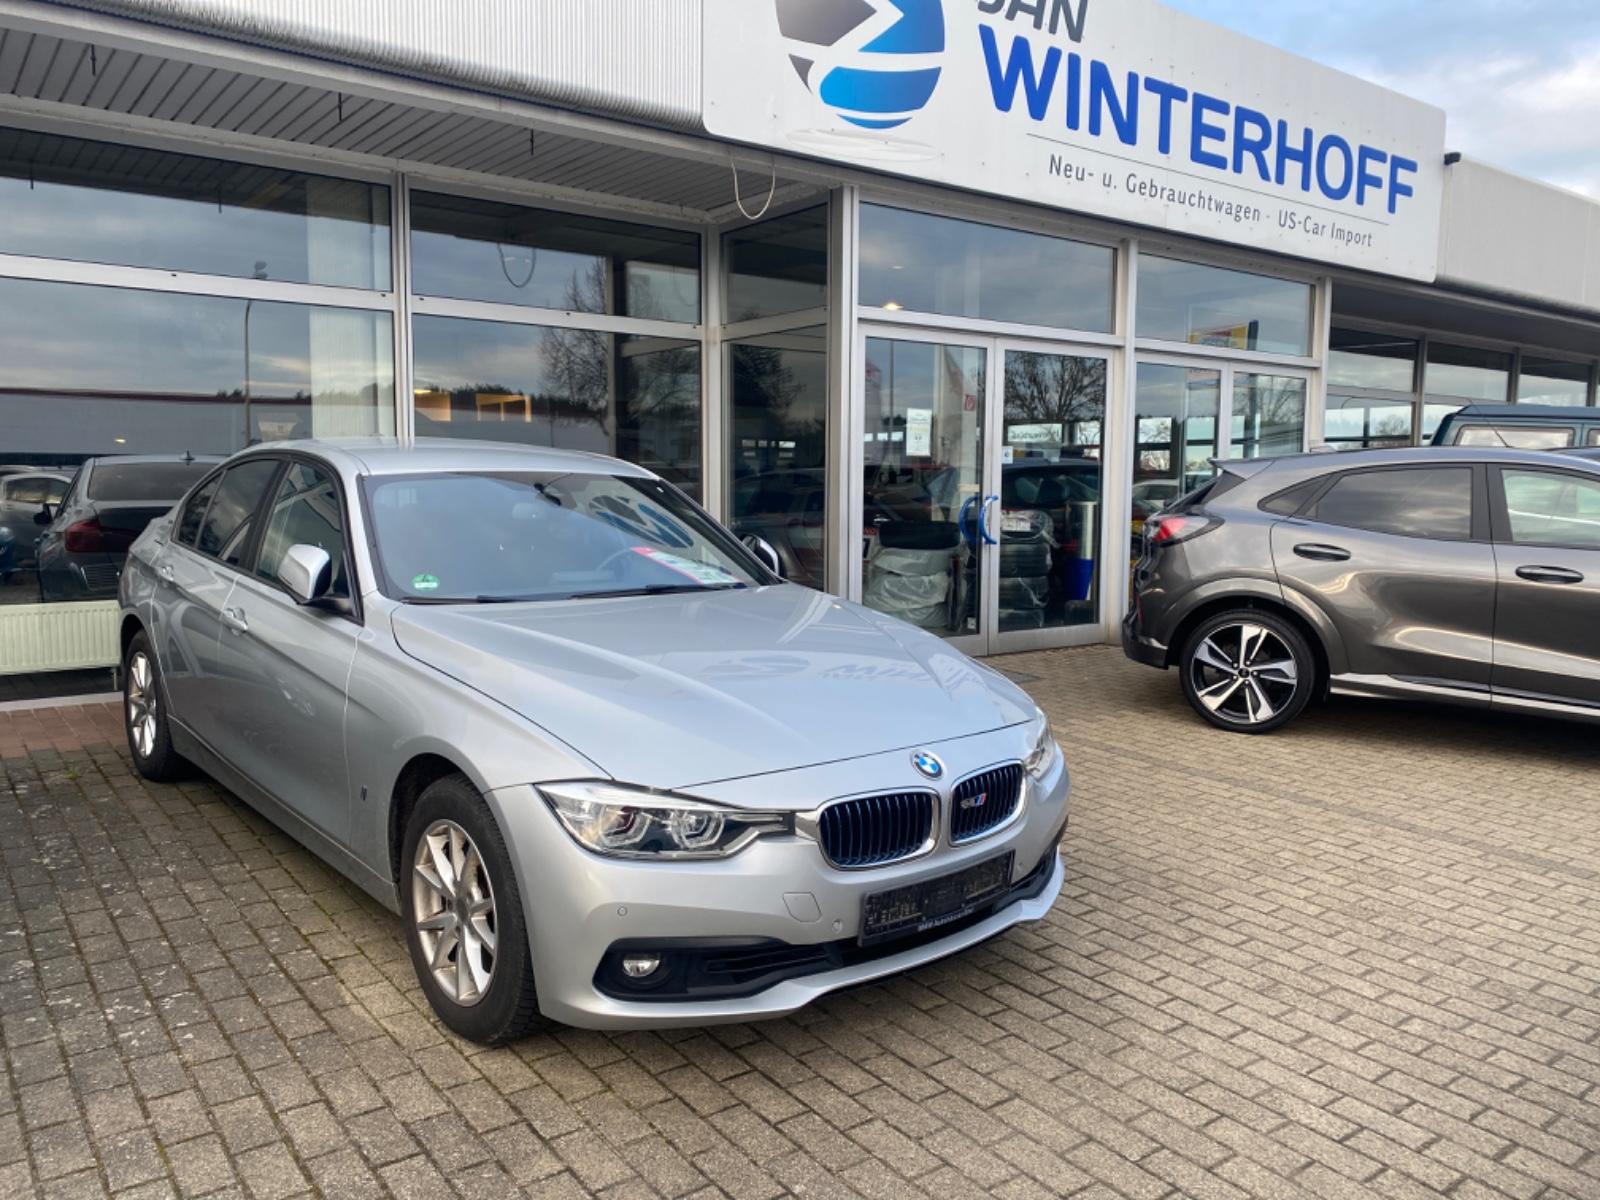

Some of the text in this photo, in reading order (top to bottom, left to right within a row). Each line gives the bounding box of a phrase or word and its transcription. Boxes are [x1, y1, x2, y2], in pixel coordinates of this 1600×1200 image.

[978, 23, 1418, 214] WINTERHOFF
[1049, 153, 1373, 248] Neu- u. Gebrauchtwagen US-Car Import
